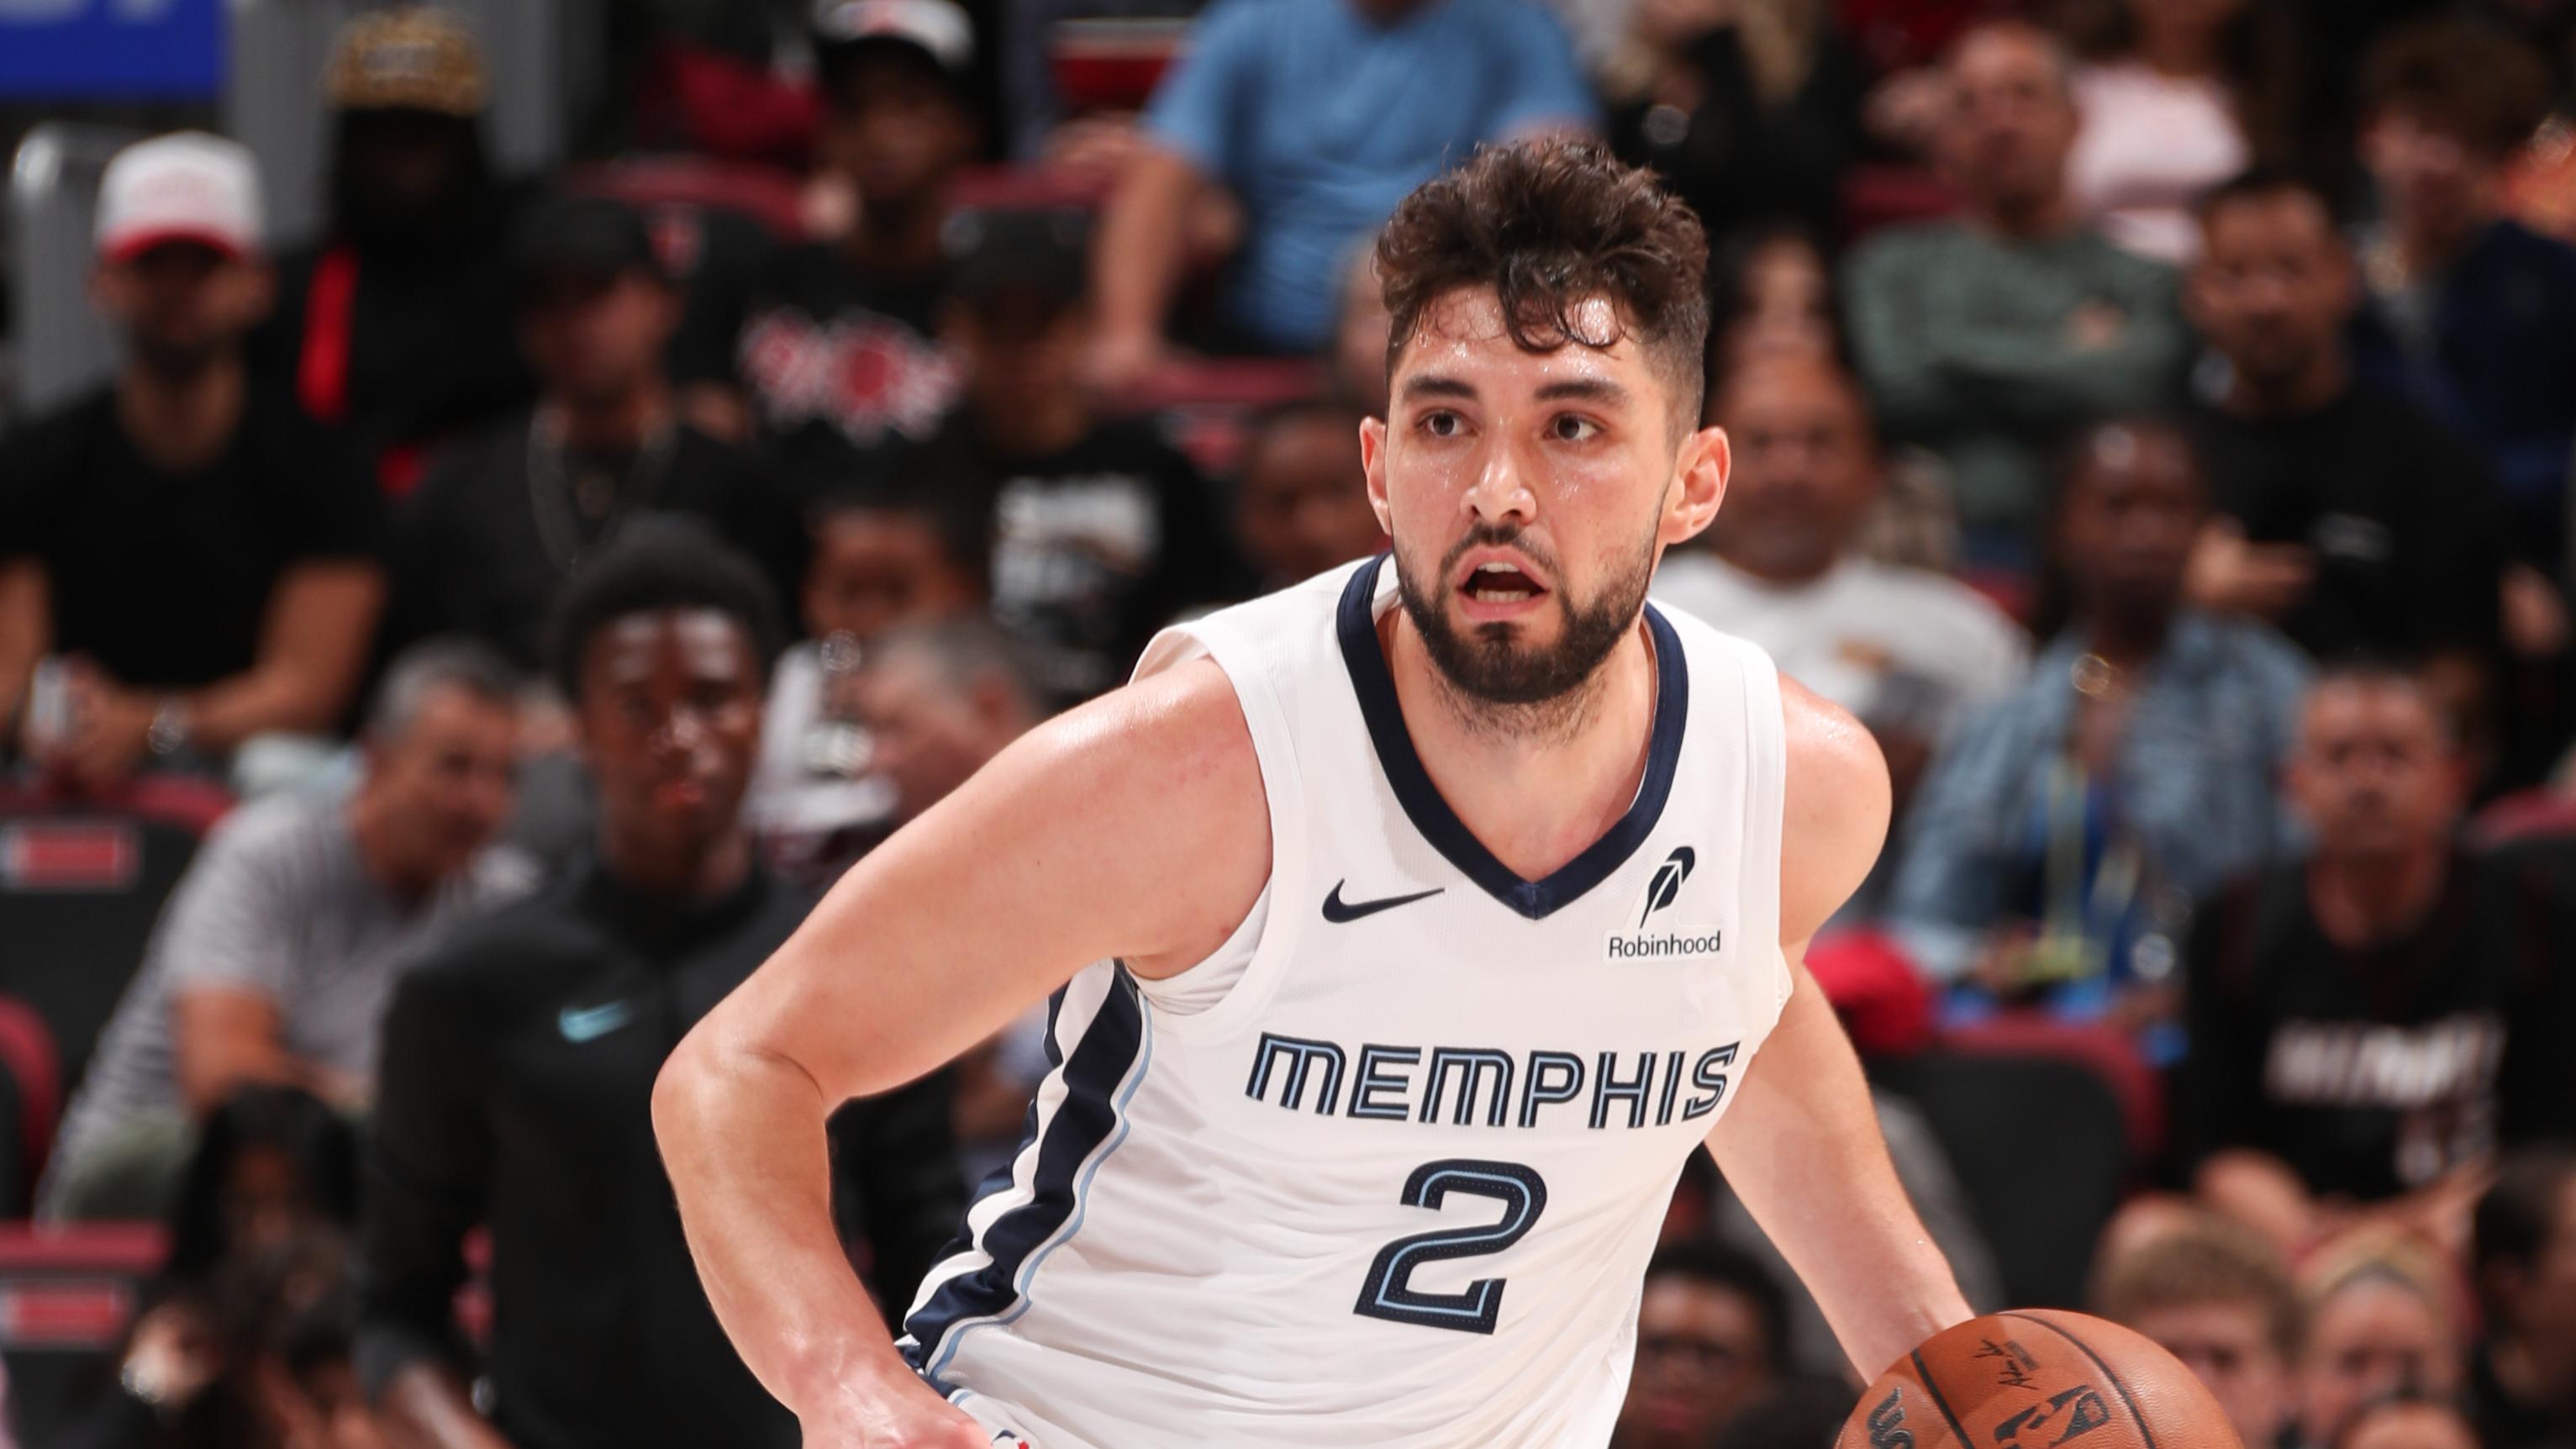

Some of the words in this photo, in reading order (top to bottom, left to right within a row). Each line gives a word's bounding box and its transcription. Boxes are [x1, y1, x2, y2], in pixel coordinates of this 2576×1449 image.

[1609, 930, 1720, 958] Robinhood
[1245, 1031, 1741, 1130] MEMPHIS
[1352, 1158, 1547, 1335] 2
